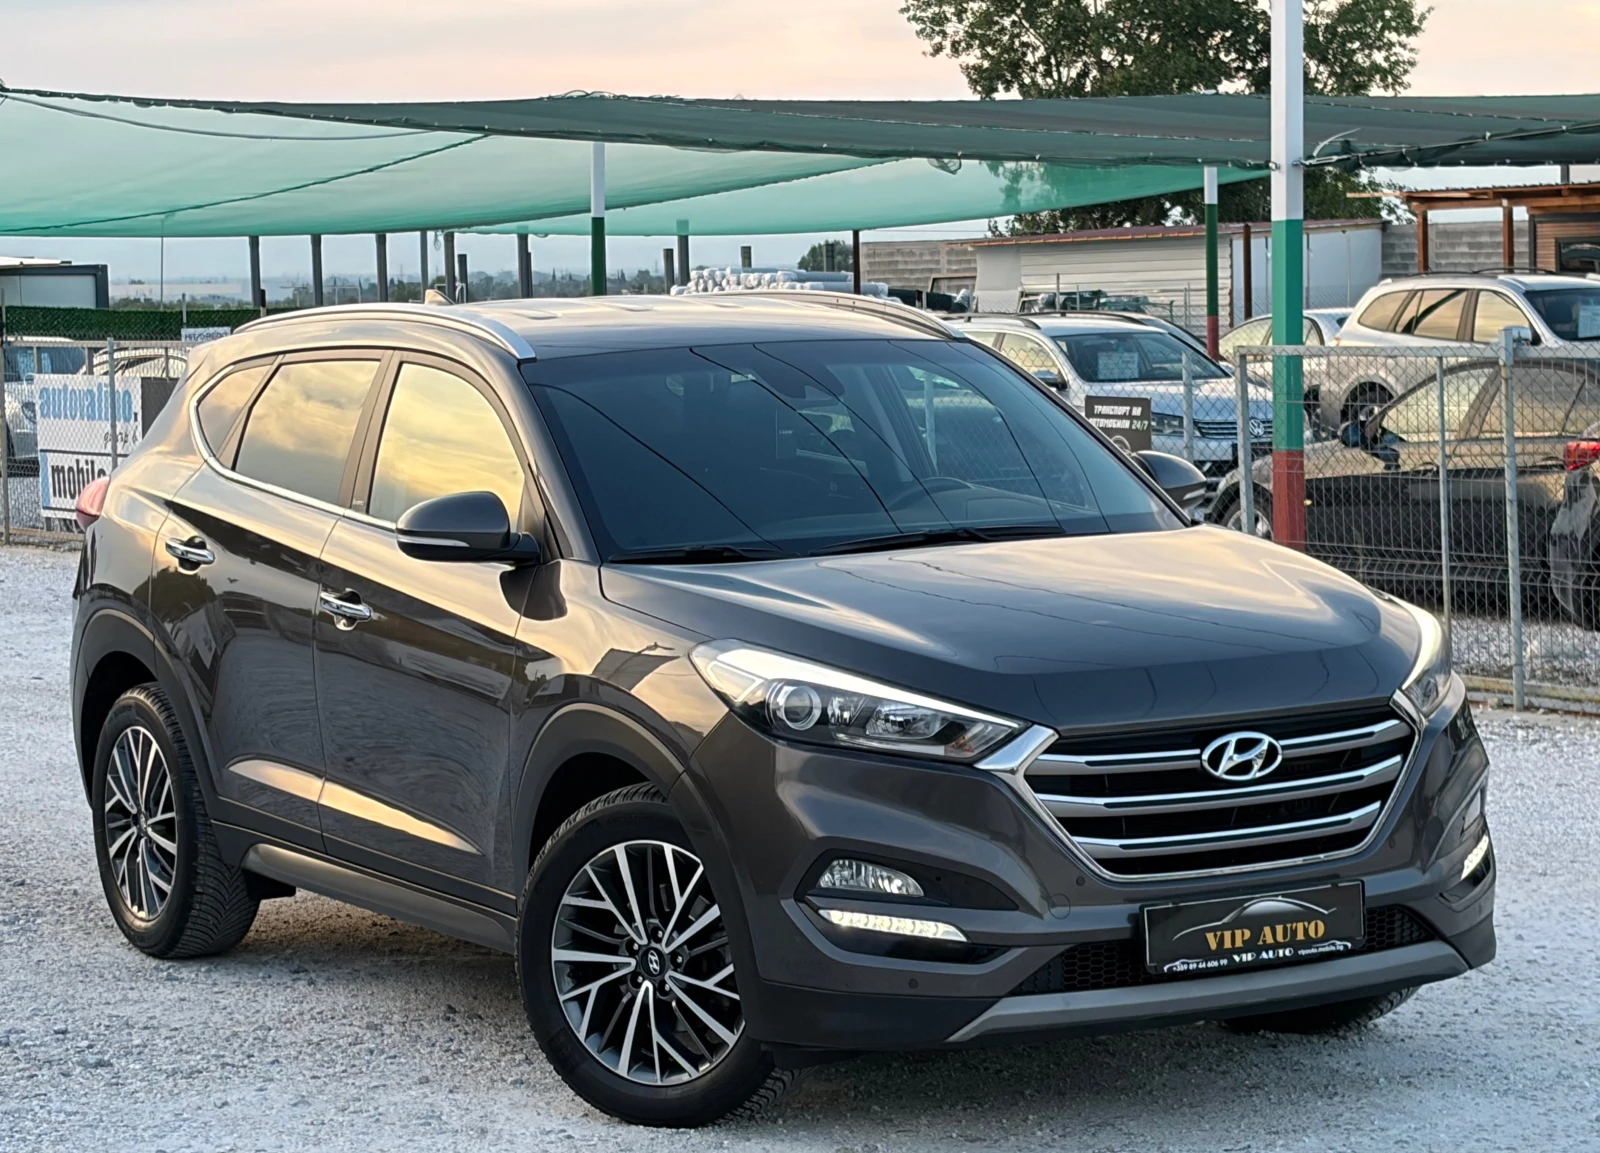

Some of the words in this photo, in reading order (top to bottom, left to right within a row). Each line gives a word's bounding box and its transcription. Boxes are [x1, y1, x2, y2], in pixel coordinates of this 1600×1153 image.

[1094, 405, 1130, 416] ТРАНСПОРТ
[1131, 406, 1142, 417] НА
[1131, 420, 1149, 431] 24/7
[1205, 928, 1251, 951] VIP
[1257, 919, 1325, 945] AUTO
[1232, 952, 1256, 963] VIP
[1259, 947, 1294, 959] AUTO
[1189, 962, 1197, 970] 89
